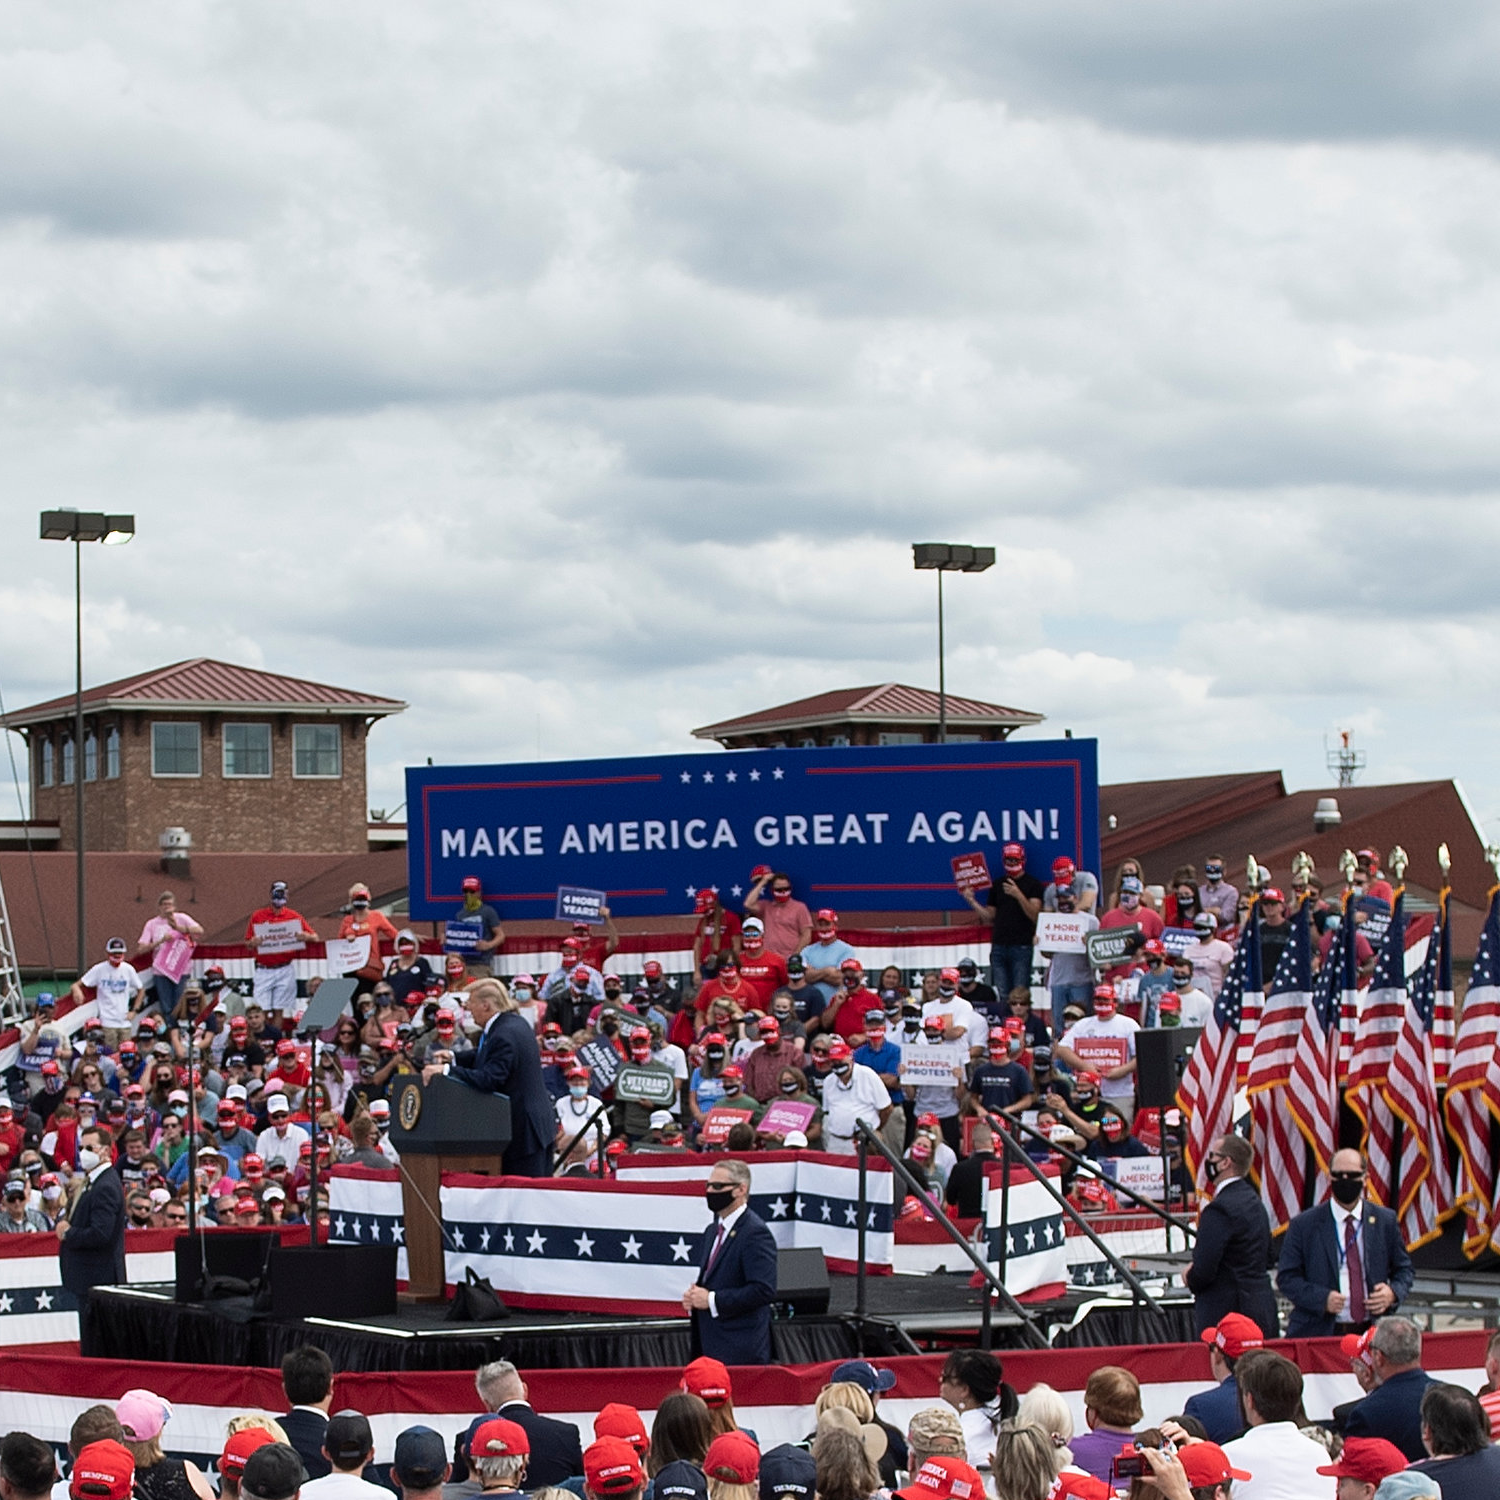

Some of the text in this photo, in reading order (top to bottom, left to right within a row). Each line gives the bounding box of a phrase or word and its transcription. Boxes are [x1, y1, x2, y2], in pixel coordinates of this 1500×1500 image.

[441, 808, 1059, 857] MAKE AMERICA GREAT AGAIN!
[563, 895, 599, 906] 4 MORE
[1053, 924, 1080, 932] MORE
[1079, 1048, 1121, 1057] PEACEFUL
[908, 1060, 951, 1068] PEACEFUL
[908, 1068, 952, 1077] PROTEST
[627, 1075, 669, 1090] VETERANS
